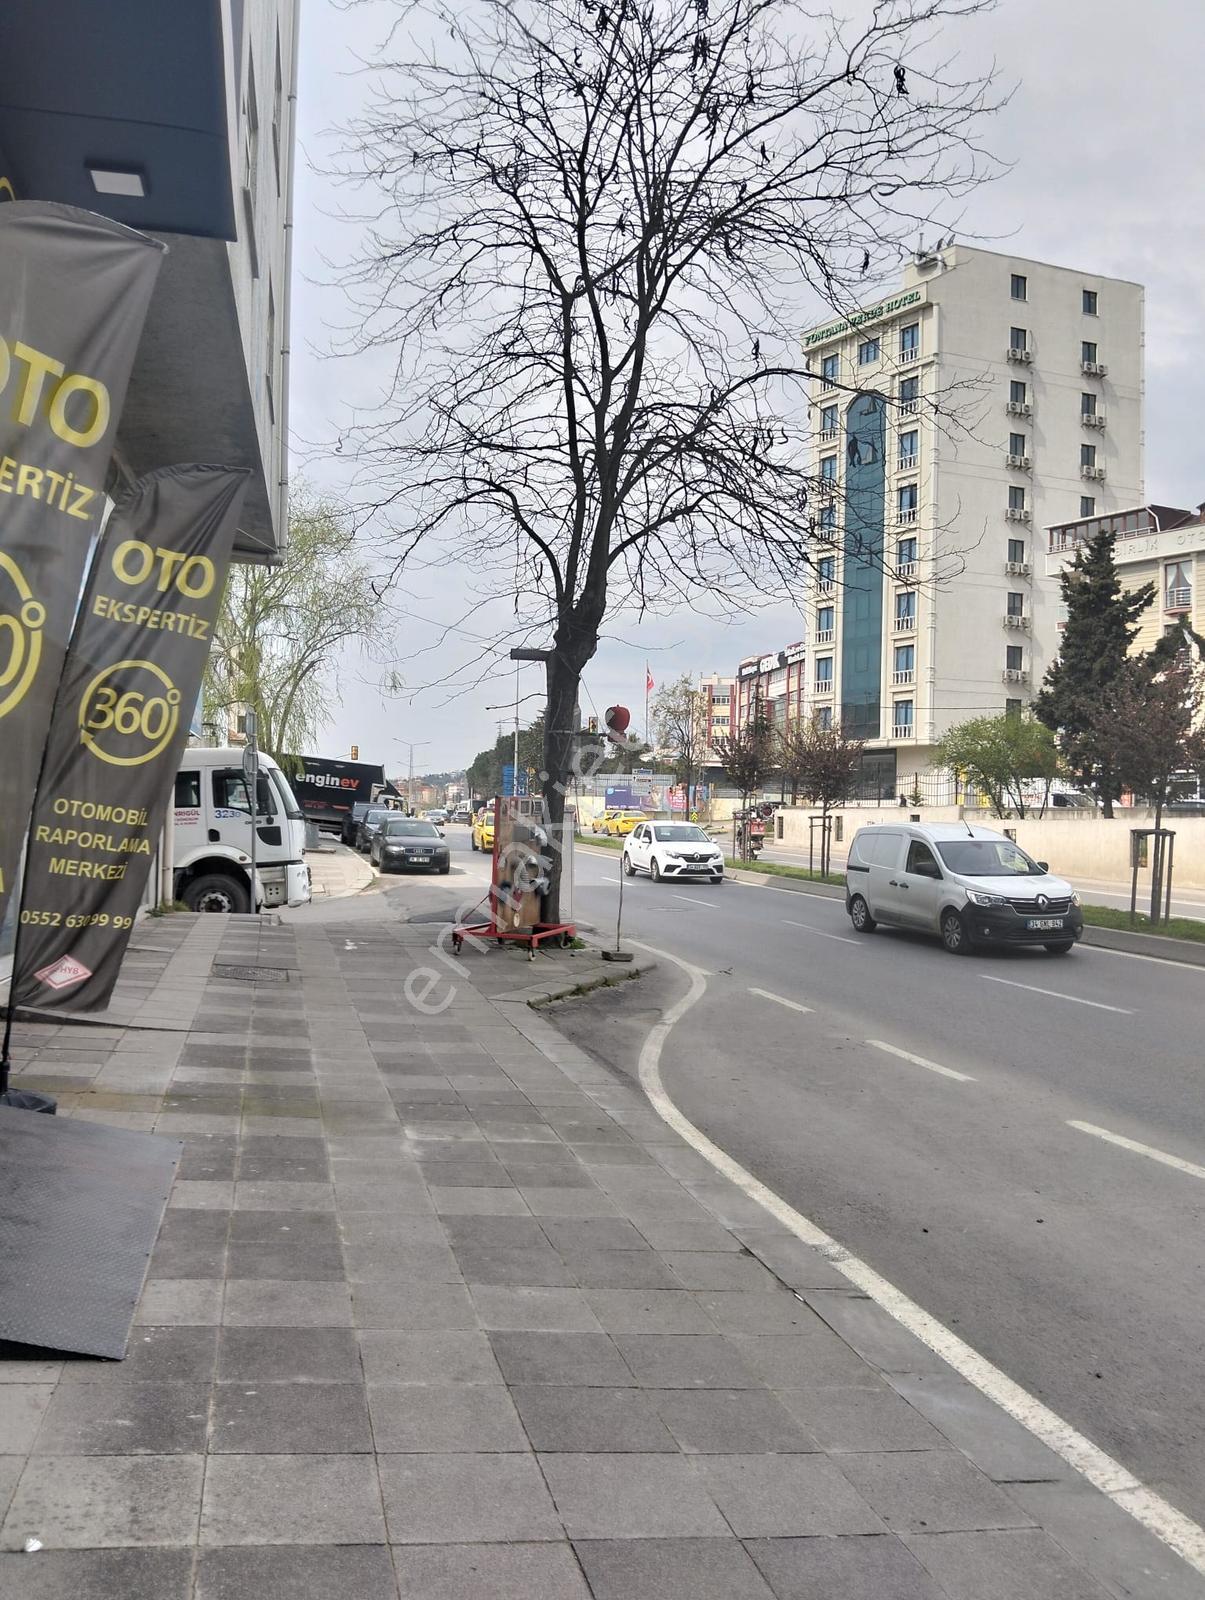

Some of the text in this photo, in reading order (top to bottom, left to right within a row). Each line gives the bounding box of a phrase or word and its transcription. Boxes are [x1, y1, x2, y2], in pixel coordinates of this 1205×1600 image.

[886, 291, 921, 313] HOTEL
[0, 335, 110, 447] TO
[112, 540, 215, 599] OTO
[93, 595, 209, 641] EKSPERTİZ
[295, 773, 360, 788] enginev
[54, 798, 149, 826] OTOMOBİL
[35, 825, 151, 855] RAPORLAMA
[48, 857, 129, 880] MERKEZİ
[20, 910, 61, 926] 0552
[112, 915, 132, 929] 99
